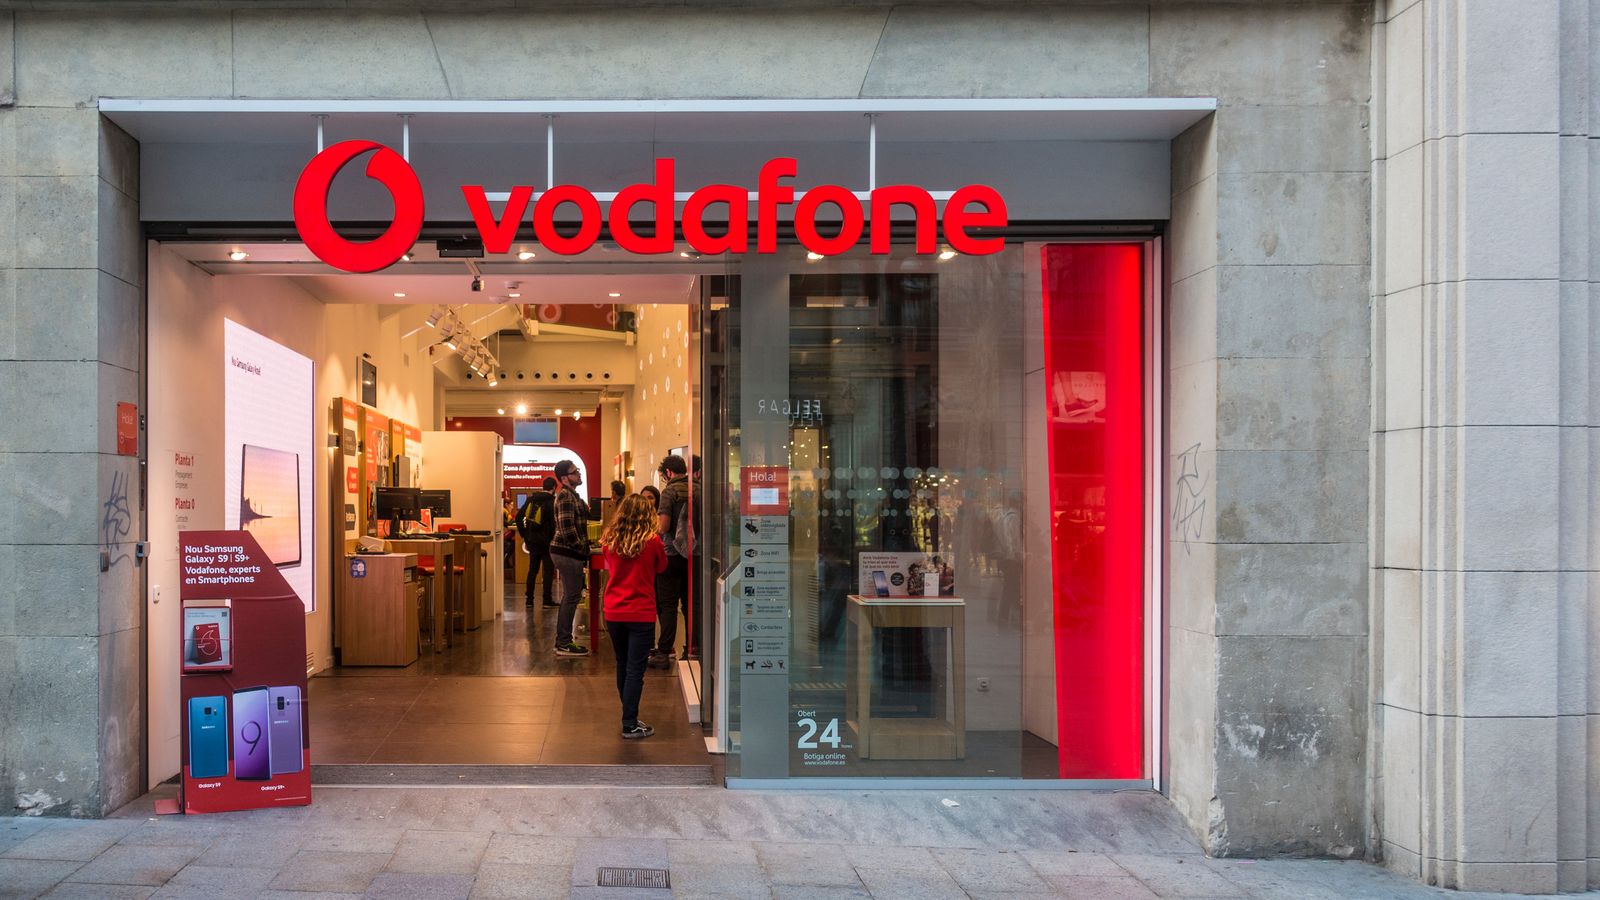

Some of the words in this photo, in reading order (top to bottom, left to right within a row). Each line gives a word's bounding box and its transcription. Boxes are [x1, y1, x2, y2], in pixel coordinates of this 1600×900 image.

[460, 158, 1008, 255] vodafone
[175, 453, 191, 466] Planta
[750, 471, 777, 482] Hola!
[175, 498, 191, 510] Planta
[185, 545, 203, 554] Nou
[204, 544, 244, 554] Samsung
[185, 555, 215, 564] Galaxy
[217, 554, 229, 562] S9
[234, 554, 250, 562] S9+
[185, 565, 227, 575] Vodafone,
[229, 565, 261, 575] experts
[198, 575, 255, 585] Smartphones
[797, 718, 841, 748] 24
[241, 720, 262, 757] 9
[804, 753, 824, 761] Botiga
[198, 782, 216, 790] Galaxy
